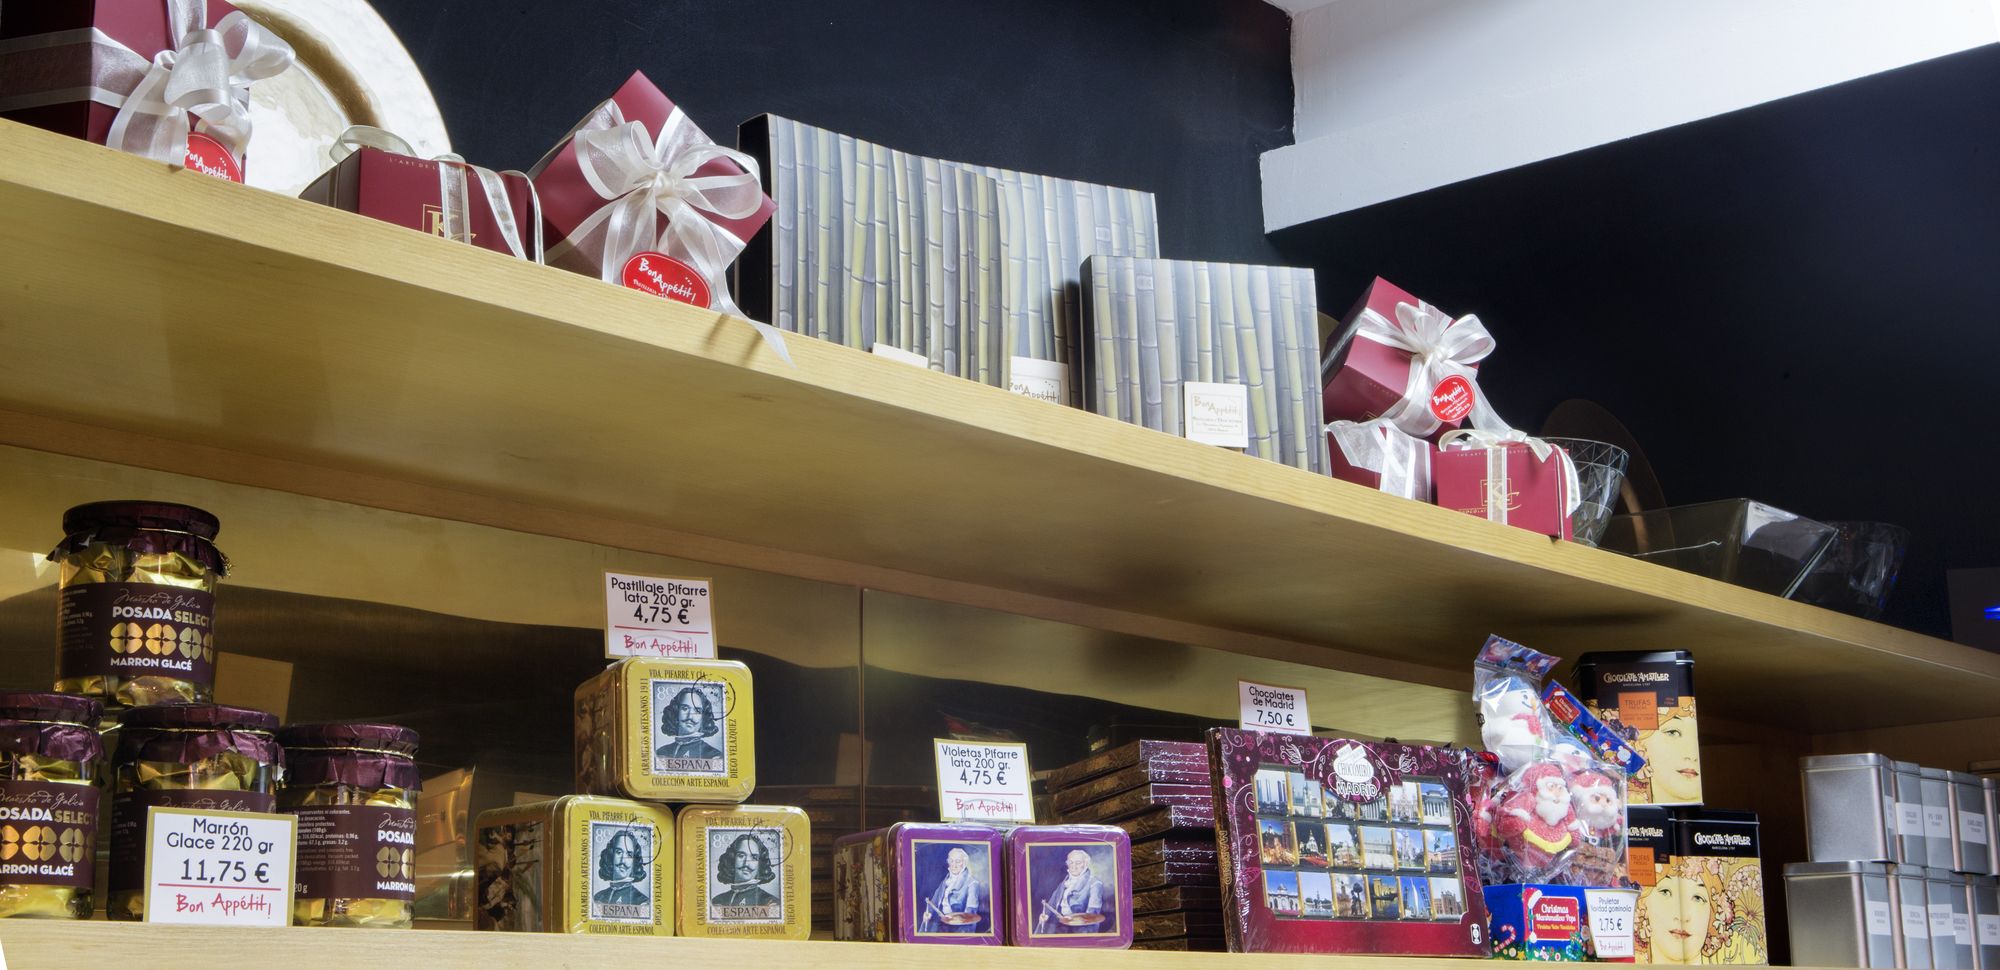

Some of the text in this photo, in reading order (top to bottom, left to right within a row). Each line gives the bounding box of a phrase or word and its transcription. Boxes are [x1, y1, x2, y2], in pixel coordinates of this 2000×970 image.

[639, 257, 658, 278] Bon
[653, 274, 697, 305] Appétit!
[611, 577, 707, 597] Pastillaje Pifarre
[624, 590, 695, 609] lata 200 gr.
[112, 606, 173, 620] POSADA
[633, 604, 690, 625] 4,75 €
[623, 634, 698, 657] Bon Appétit!
[110, 657, 193, 672] MARRON GLACÉ
[1249, 686, 1294, 701] Chocolates
[1253, 697, 1294, 710] de Madrid
[640, 695, 650, 735] ARTESANOS
[1257, 709, 1294, 726] 7,50 €
[641, 737, 650, 776] CARAMELOS
[941, 744, 1018, 760] Violetas Pifarre
[667, 757, 711, 770] ESPAÑA
[730, 757, 738, 778] DIEGO
[951, 757, 1011, 771] lata 200 gr.
[651, 777, 729, 788] COLECCIÓN ARTE ESPAÑOL
[959, 768, 1007, 786] 4,75 €
[1336, 782, 1377, 797] MADRID
[955, 798, 974, 812] Bon
[192, 817, 249, 836] Marrón
[166, 832, 274, 855] Glace 220 gr
[377, 830, 414, 845] POSADA
[581, 838, 589, 879] ARTESANOS
[696, 845, 704, 883] ARTESANOS
[0, 864, 74, 877] RRON GLACÉ
[180, 858, 270, 884] 11,75 €
[376, 881, 408, 891] MARRON
[175, 892, 272, 919] Bon Appétit!
[581, 880, 589, 923] CARAMELOS
[696, 884, 704, 926] CARAMELOS
[1541, 903, 1569, 914] Christmas
[602, 904, 640, 917] ESPAÑA
[722, 906, 768, 917] ESPAÑA
[618, 925, 632, 935] ARTE
[632, 924, 654, 935] ESPAÑOL
[743, 925, 758, 935] ARTE
[759, 925, 786, 935] ESPAÑOL
[1617, 918, 1623, 931] €
